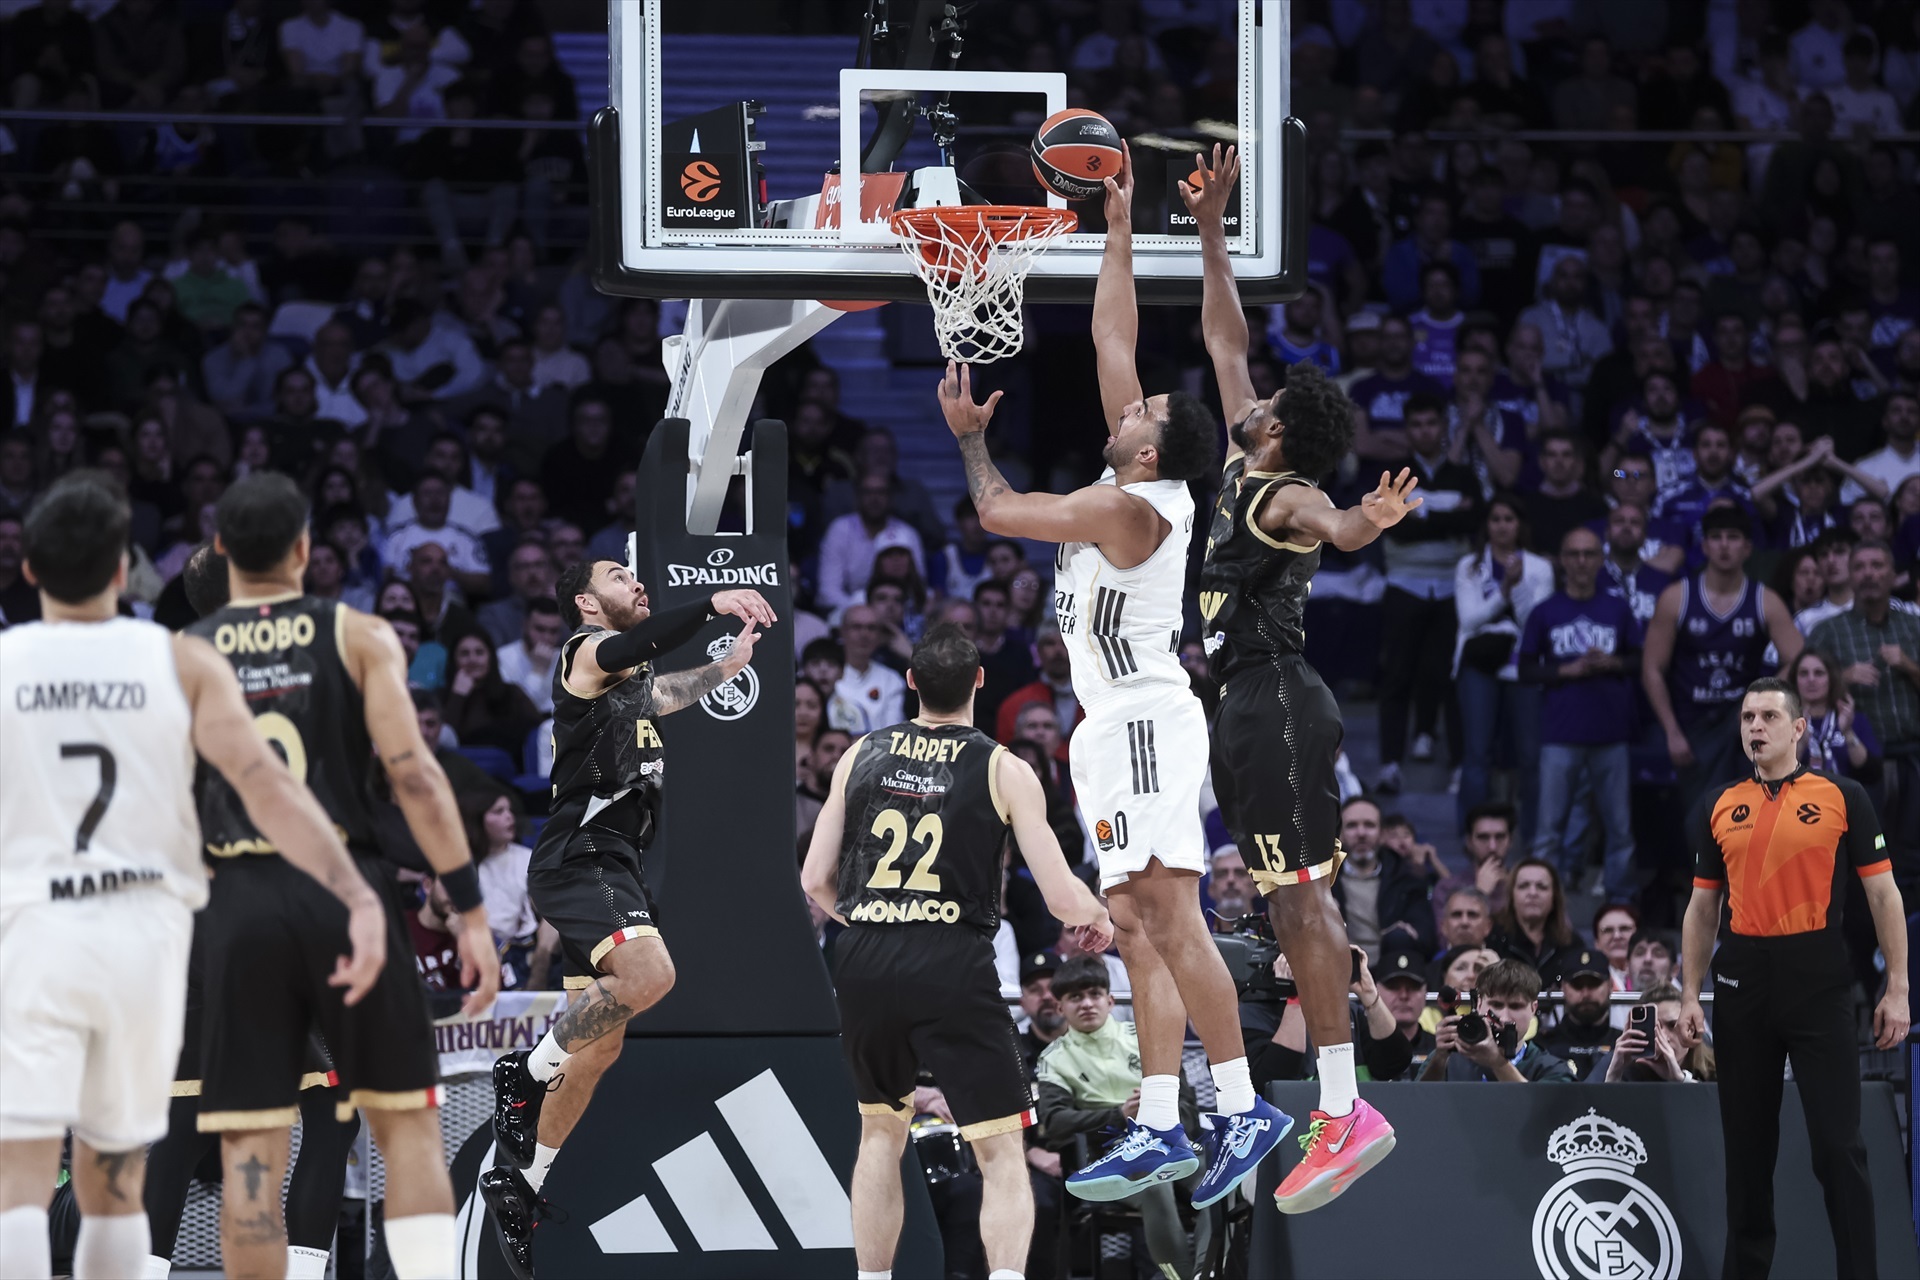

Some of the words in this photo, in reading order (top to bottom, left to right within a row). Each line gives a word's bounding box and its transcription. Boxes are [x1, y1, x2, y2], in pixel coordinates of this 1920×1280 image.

[666, 206, 736, 221] EuroLeague
[1170, 213, 1238, 225] Euroue
[667, 563, 779, 587] SPALDING
[215, 613, 315, 655] OKOBO
[16, 682, 146, 712] CAMPAZZO
[890, 731, 967, 762] TARPEY
[881, 776, 916, 793] MICHEL
[896, 769, 933, 786] GROUPE
[60, 742, 117, 855] 7
[1115, 810, 1128, 850] 0
[1726, 823, 1754, 834] motorola
[866, 808, 943, 892] 22
[1254, 833, 1287, 873] 13
[851, 899, 961, 923] MONACO
